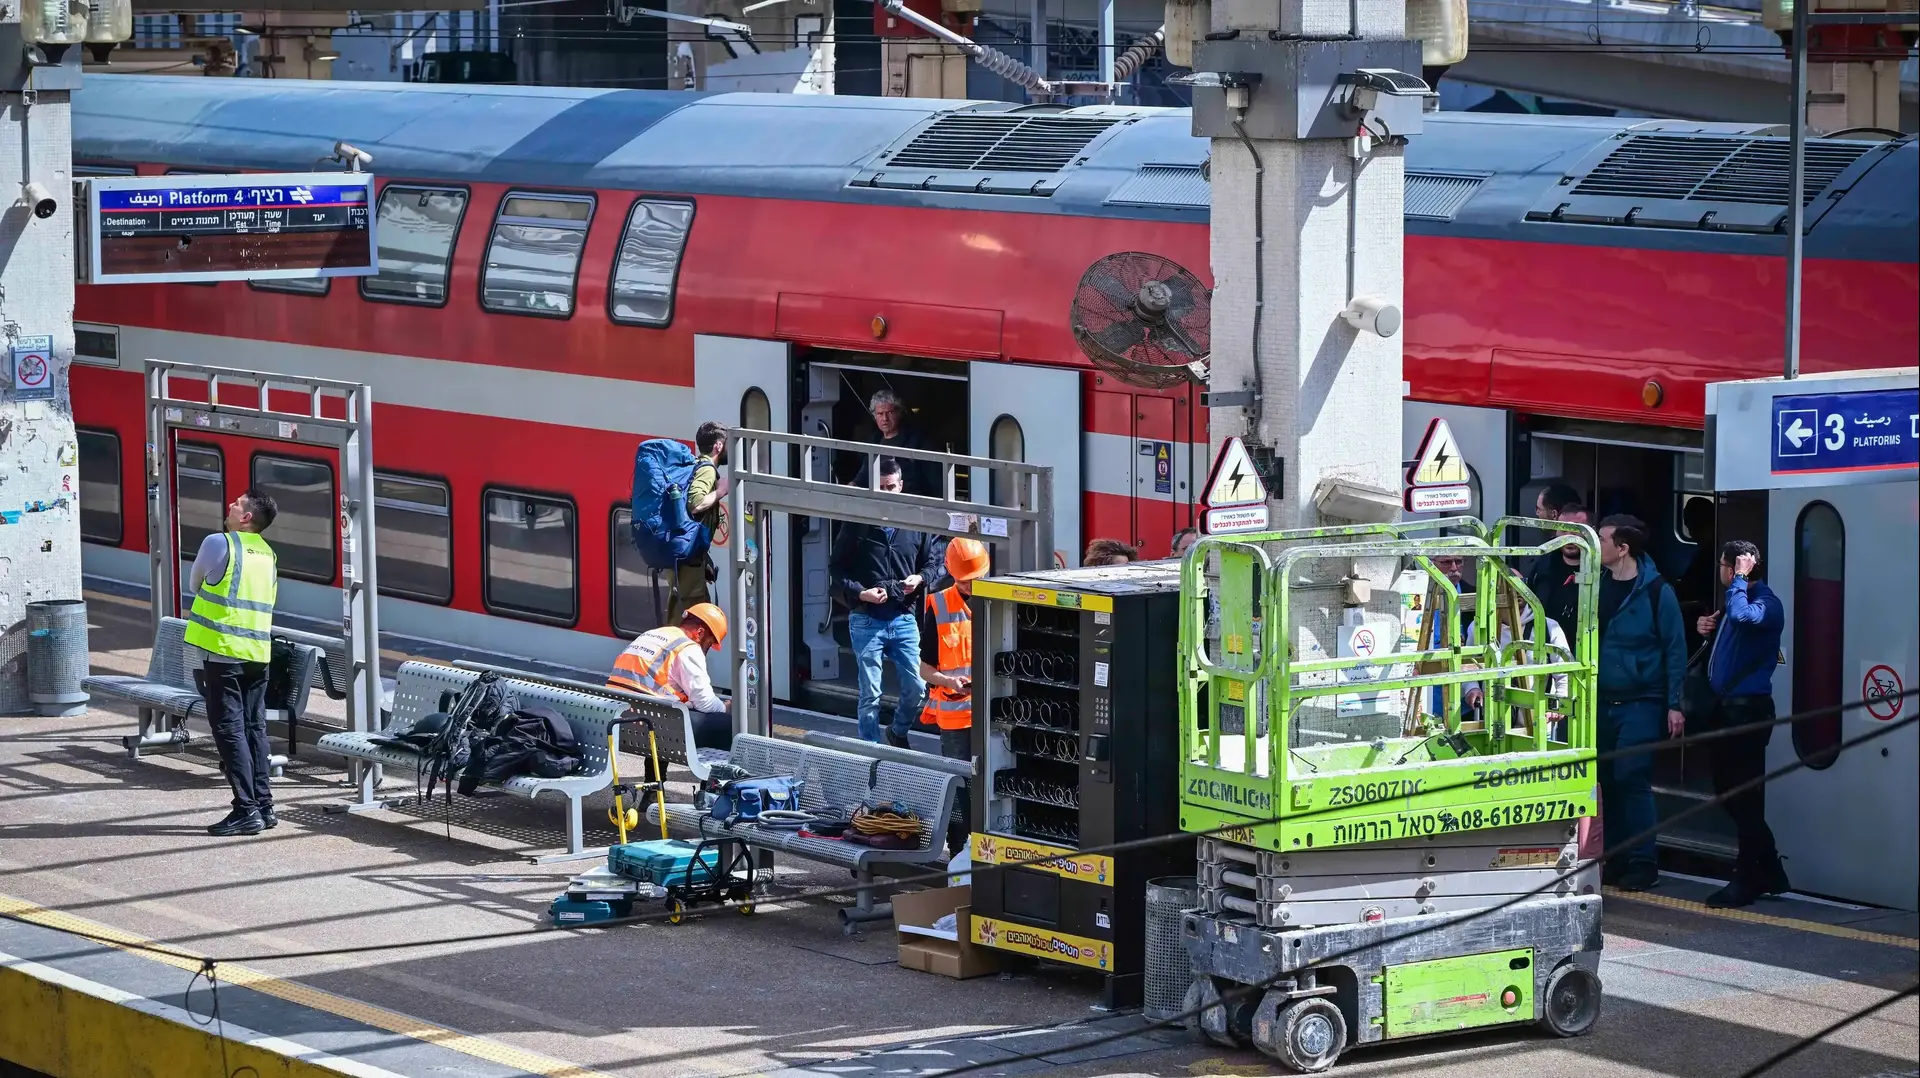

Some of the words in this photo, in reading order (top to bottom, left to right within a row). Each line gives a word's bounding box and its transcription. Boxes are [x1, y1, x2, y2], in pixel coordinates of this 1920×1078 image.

[129, 192, 162, 206] رصيف
[169, 191, 228, 205] Platform
[234, 189, 244, 203] 4
[251, 188, 284, 206] רציף
[229, 211, 255, 221] מעודכן
[264, 210, 283, 219] שעה
[312, 213, 326, 221] יעד
[350, 208, 368, 216] רכבת
[106, 217, 146, 226] Destination
[171, 217, 194, 226] ביניים
[195, 216, 219, 225] תחנות
[264, 220, 282, 228] Time
[354, 217, 366, 225] No.
[1854, 412, 1892, 429] رصيف
[1824, 413, 1846, 451] 3
[1853, 434, 1901, 447] PLATFORMS
[1473, 760, 1588, 790] ZOOMLION
[1187, 778, 1271, 811] ZOOMLION
[1328, 778, 1427, 806] ZS0607DC
[1461, 799, 1568, 830] 08-6187977
[1333, 819, 1392, 844] הרמות
[1397, 813, 1436, 838] סאל
[1006, 930, 1032, 945] אוהבים
[1051, 936, 1080, 959] חטיפים
